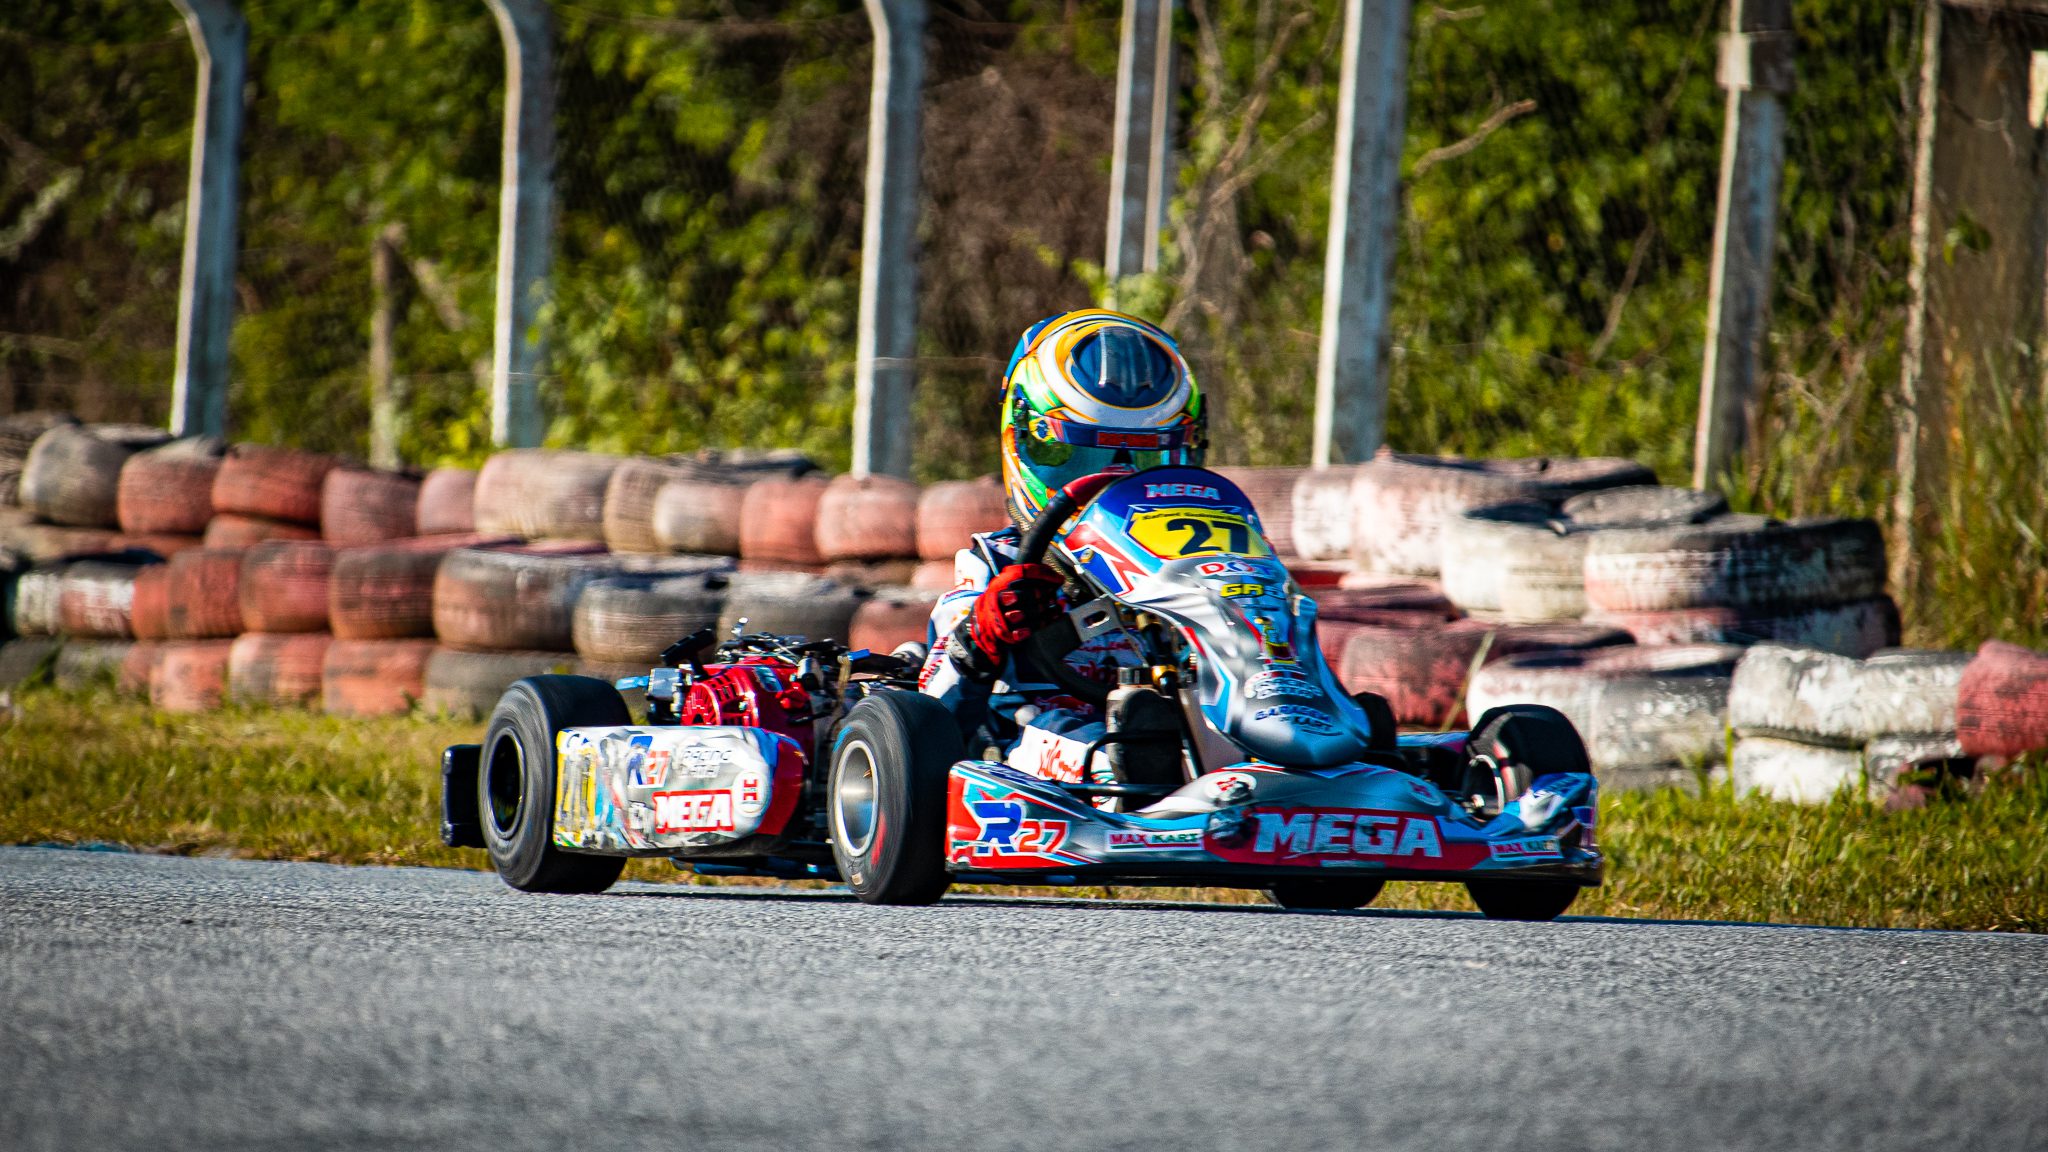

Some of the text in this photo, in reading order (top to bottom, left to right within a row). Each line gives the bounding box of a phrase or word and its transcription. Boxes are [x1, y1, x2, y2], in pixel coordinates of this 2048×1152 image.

[1144, 484, 1220, 500] MEGA
[1166, 518, 1249, 555] 27
[656, 793, 733, 829] MEGA
[972, 801, 1069, 855] R27
[1110, 832, 1199, 845] MAX KART
[1253, 812, 1442, 858] MEGA
